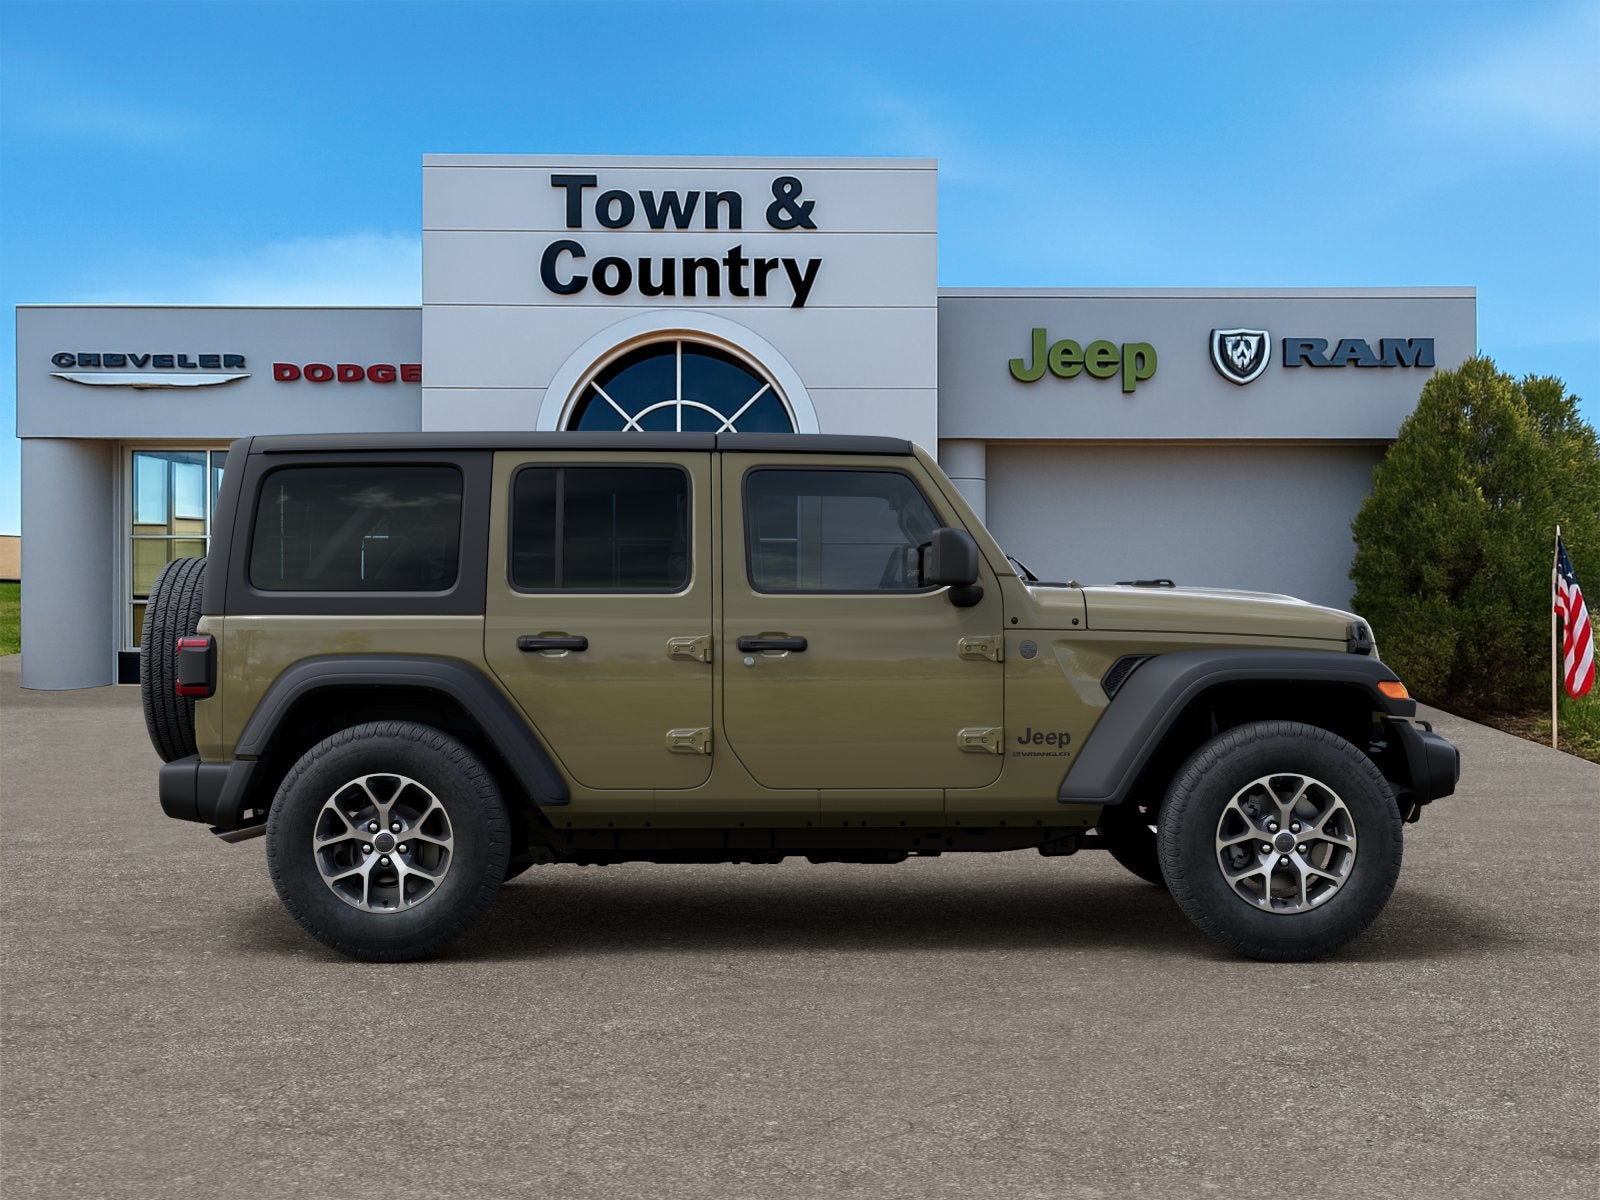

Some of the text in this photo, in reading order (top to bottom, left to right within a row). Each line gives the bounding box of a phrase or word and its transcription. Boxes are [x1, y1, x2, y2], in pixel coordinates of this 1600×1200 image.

[550, 174, 818, 230] Town &
[539, 239, 823, 308] Country
[272, 363, 422, 384] DODGE
[1008, 327, 1158, 393] Jeep
[1281, 337, 1436, 368] RAM
[1017, 727, 1071, 748] Jeep
